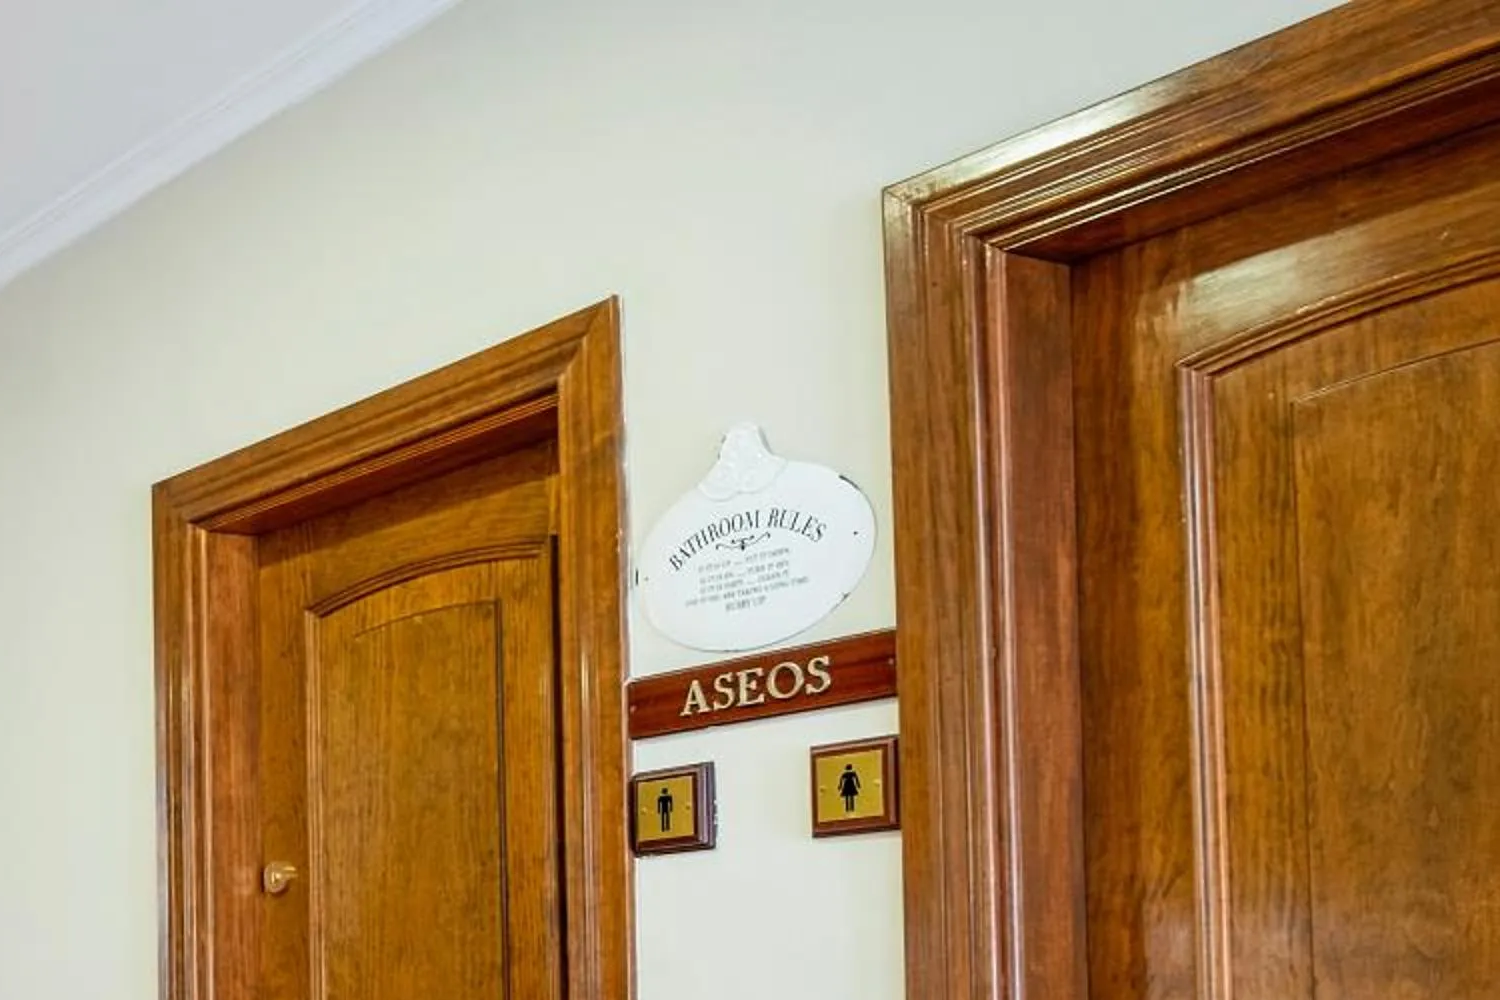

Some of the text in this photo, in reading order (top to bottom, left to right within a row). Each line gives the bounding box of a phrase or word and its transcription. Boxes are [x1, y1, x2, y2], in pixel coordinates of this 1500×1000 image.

[669, 510, 760, 571] BATHROOM
[767, 507, 827, 543] RULES
[679, 655, 832, 716] ASEOS
